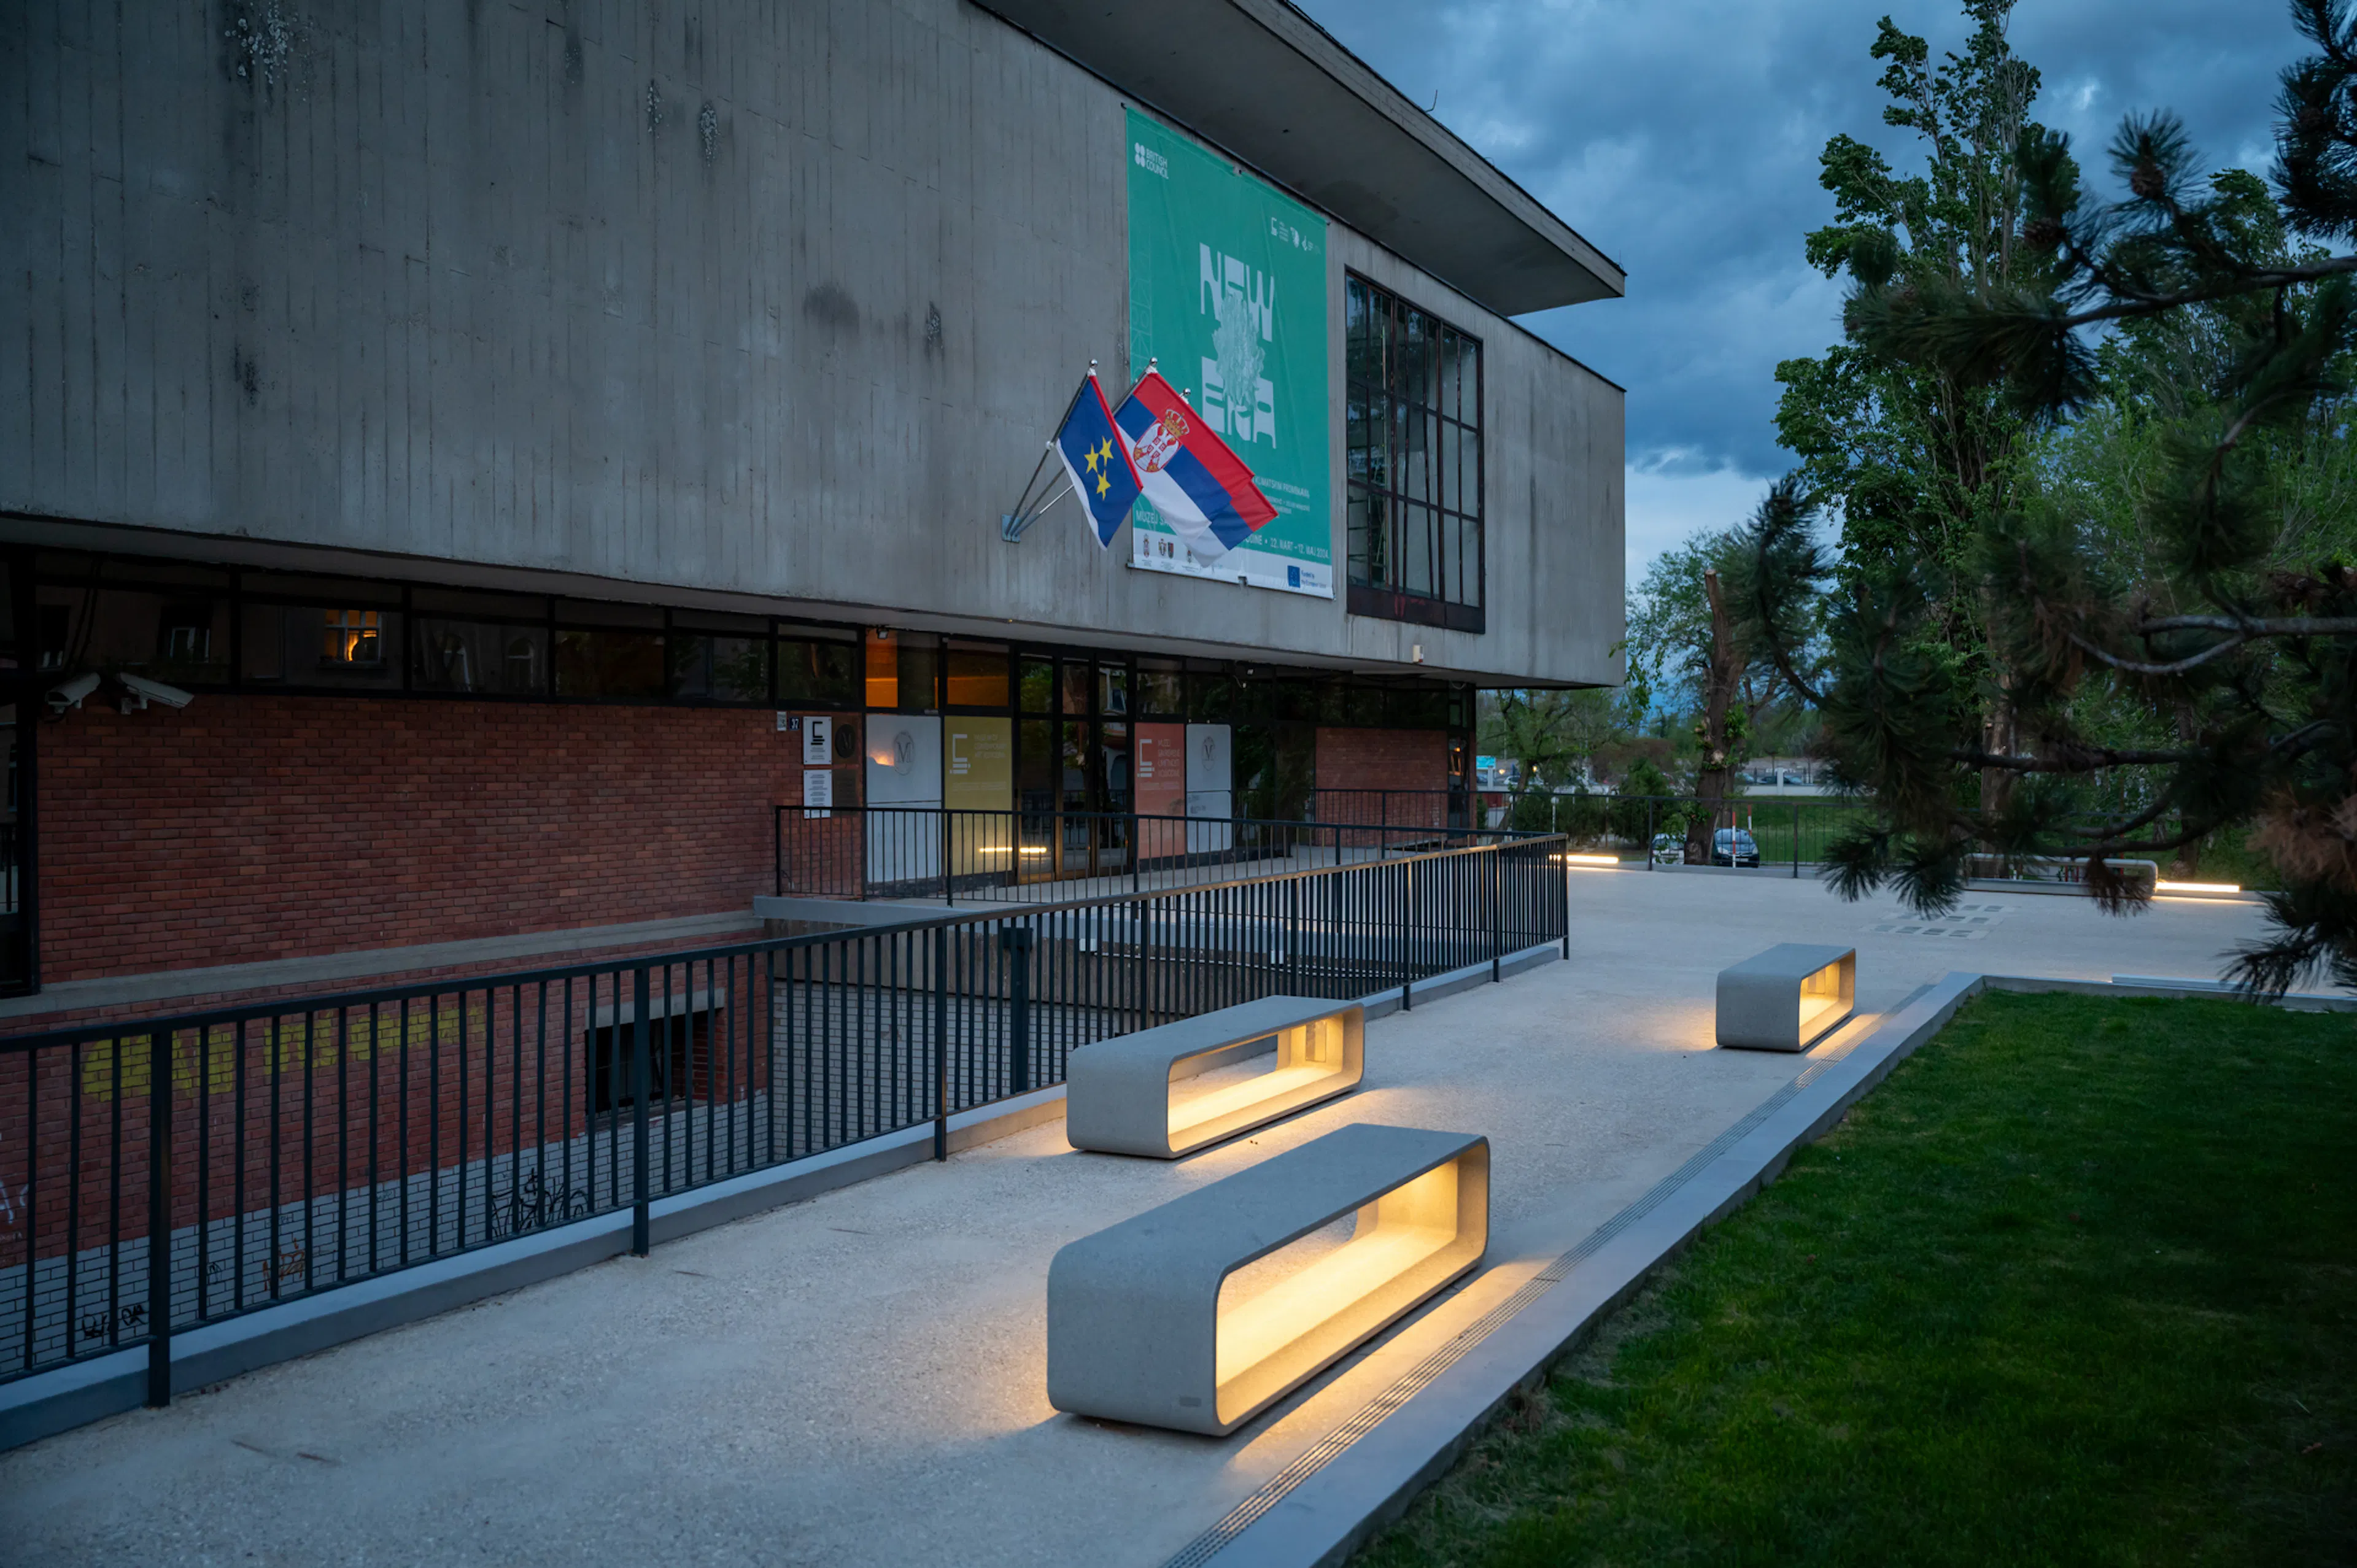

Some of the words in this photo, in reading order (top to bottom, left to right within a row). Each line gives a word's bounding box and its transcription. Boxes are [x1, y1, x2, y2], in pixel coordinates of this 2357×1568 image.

[1146, 147, 1167, 169] BRITISH
[1146, 159, 1169, 180] COUNCIL
[1199, 242, 1275, 342] NEW
